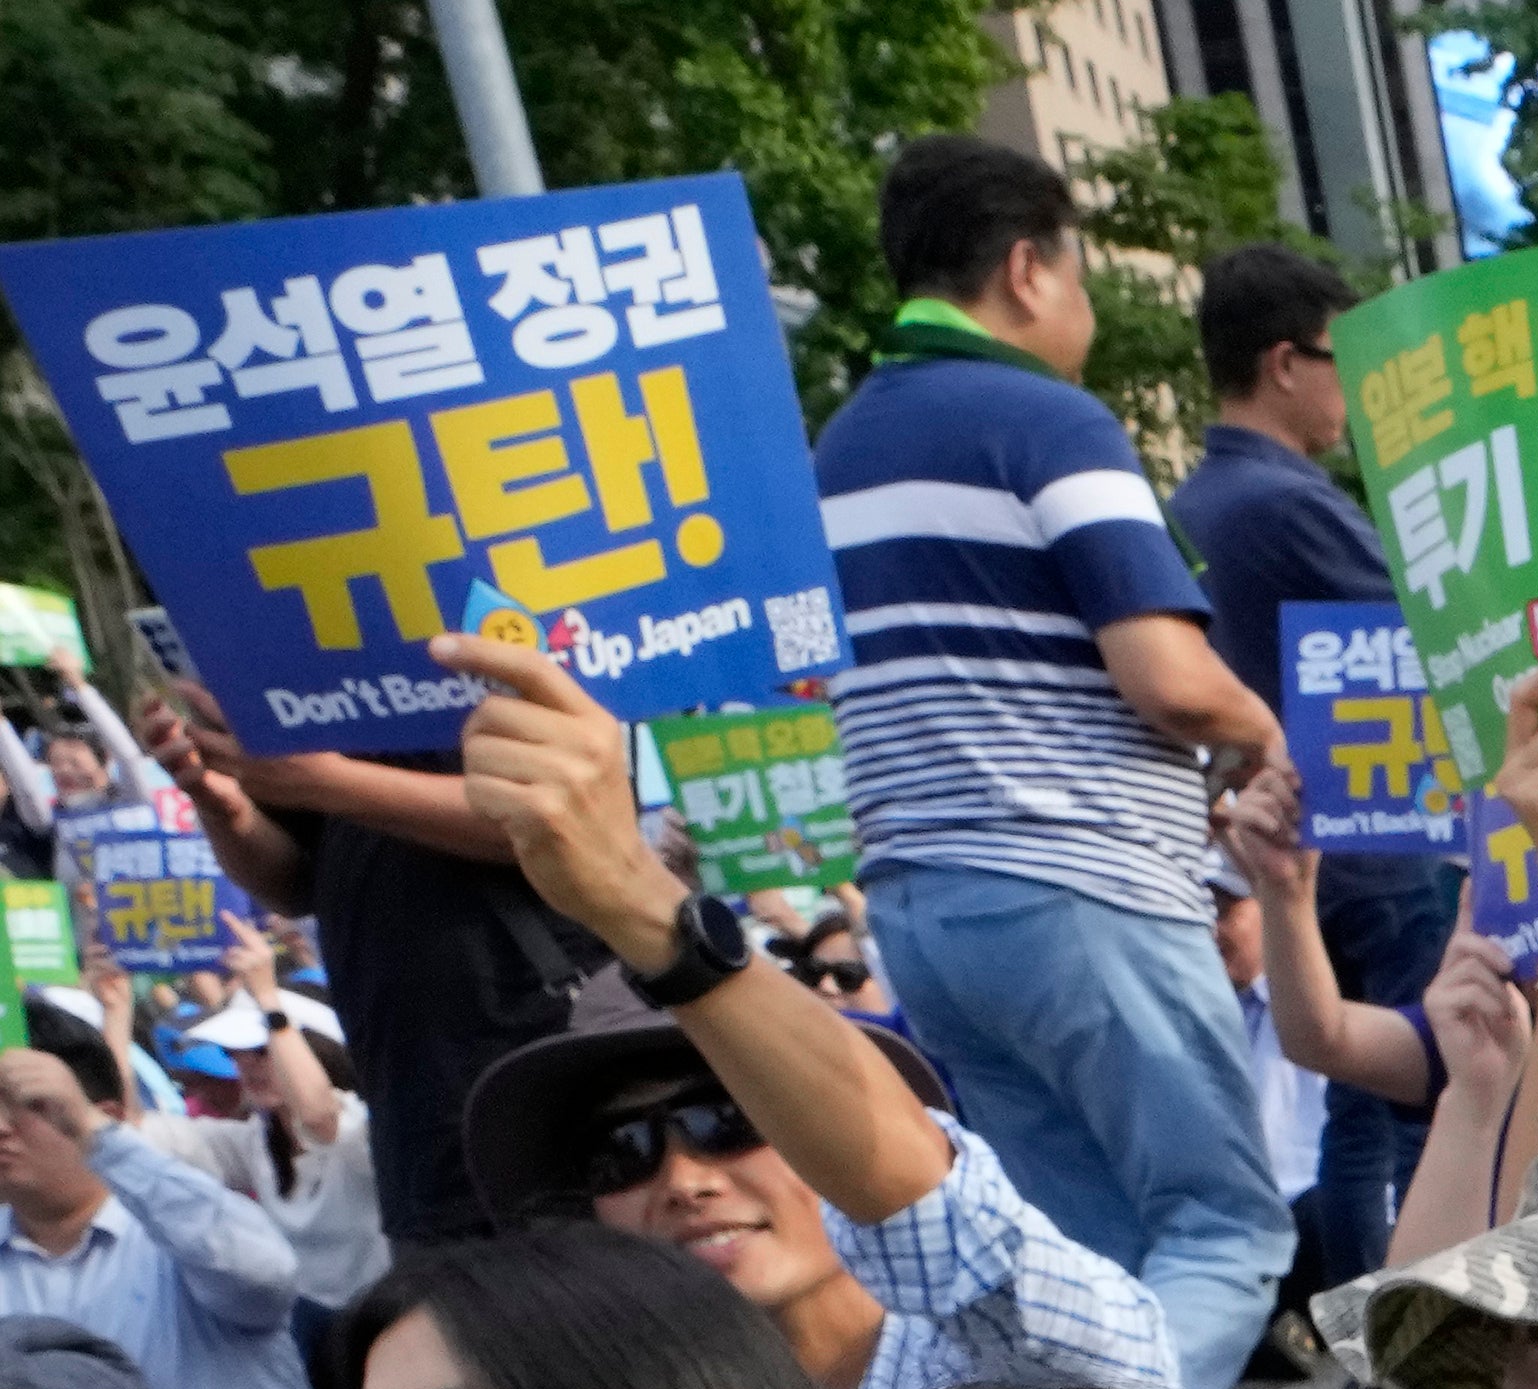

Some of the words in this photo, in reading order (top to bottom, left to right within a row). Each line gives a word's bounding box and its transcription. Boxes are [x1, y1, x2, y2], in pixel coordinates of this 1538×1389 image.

[83, 252, 485, 445] 윤석열
[478, 204, 727, 370] 정권
[1360, 333, 1455, 468] 일본
[1457, 299, 1537, 398] 핵
[221, 366, 725, 651] 규탄!
[1389, 425, 1533, 610] 투기
[263, 679, 389, 729] Don't
[574, 630, 633, 680] Up
[637, 596, 753, 663] Japan
